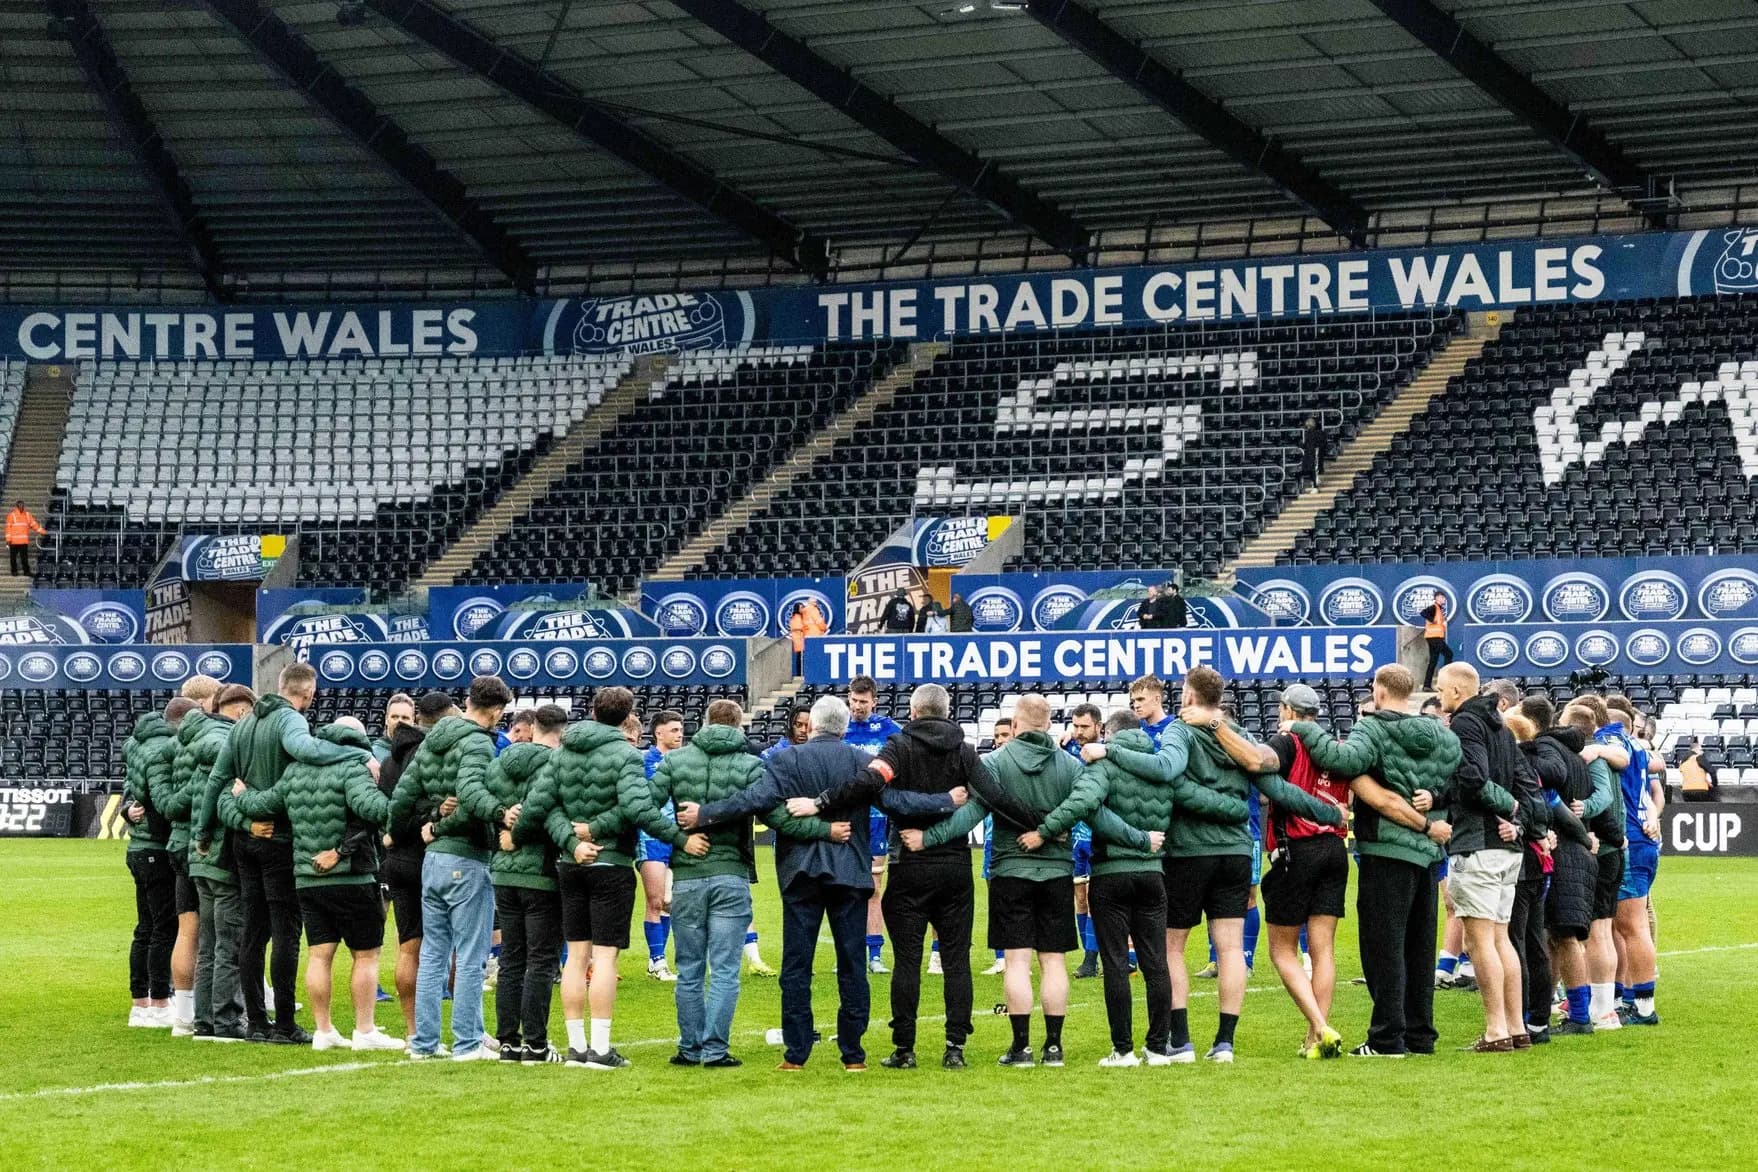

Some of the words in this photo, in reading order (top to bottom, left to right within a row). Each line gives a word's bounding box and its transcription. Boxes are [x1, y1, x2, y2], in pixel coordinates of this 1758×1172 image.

[818, 288, 917, 341] THE
[934, 276, 1123, 334] TRADE
[1142, 258, 1369, 324] CENTRE
[1388, 245, 1606, 309] WALES
[596, 293, 699, 322] TRADE
[18, 312, 254, 360] CENTRE
[273, 308, 478, 357] WALES
[607, 309, 692, 345] CENTRE
[628, 338, 673, 355] WALES
[947, 517, 978, 530] THE
[218, 536, 248, 547] THE
[942, 536, 984, 554] CENTRE
[213, 553, 257, 569] CENTRE
[861, 569, 910, 594] THE
[153, 583, 182, 605] THE
[145, 601, 191, 633] TRADE
[302, 618, 343, 633] THE
[394, 618, 420, 630] THE
[545, 613, 584, 629] THE
[290, 628, 359, 648] TRADE
[387, 629, 430, 642] TRADE
[533, 625, 600, 640] TRADE
[824, 642, 896, 679] THE
[907, 640, 1042, 679] TRADE
[1053, 638, 1213, 677] CENTRE
[1225, 634, 1373, 674] WALES
[0, 788, 73, 803] TISSOT
[1672, 812, 1741, 852] CUP
